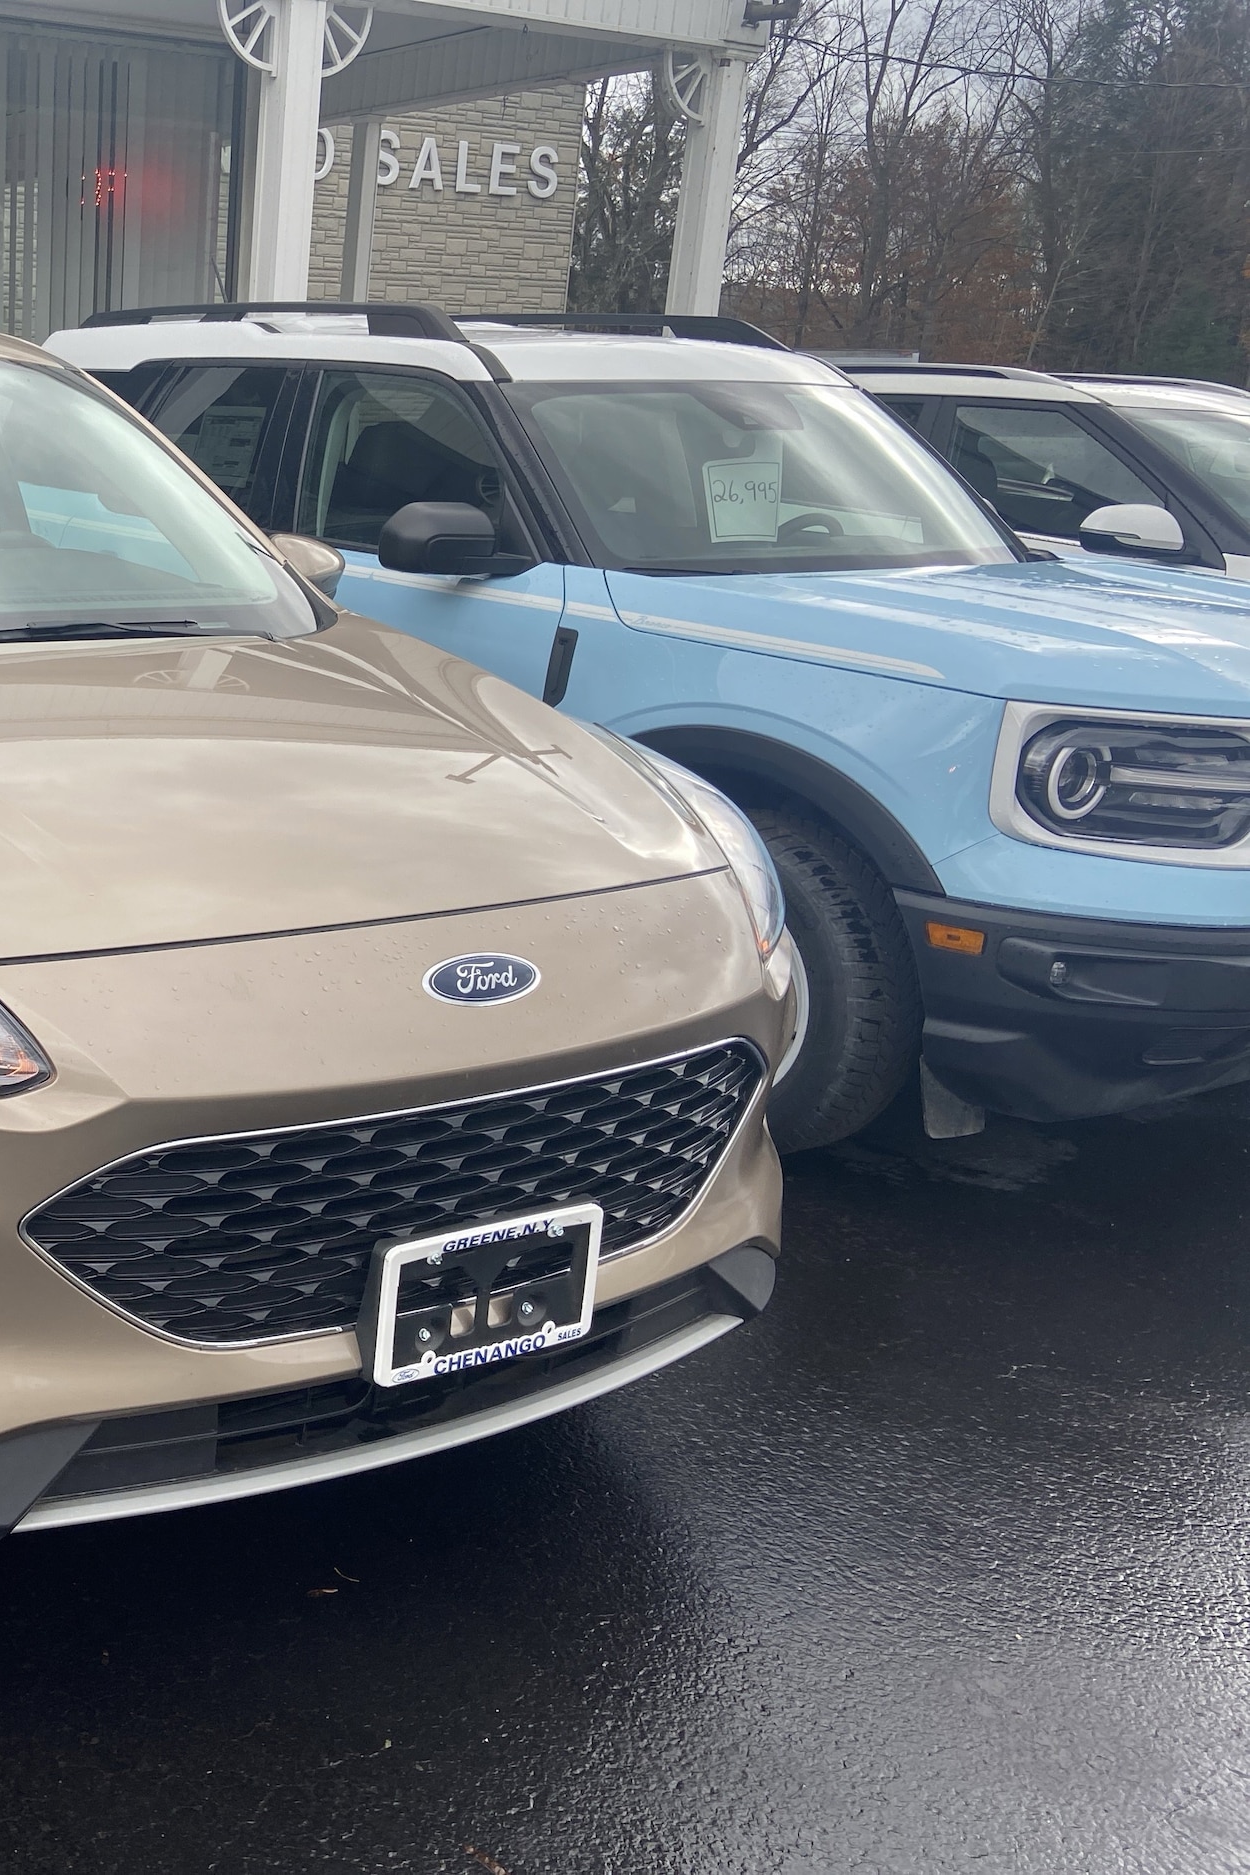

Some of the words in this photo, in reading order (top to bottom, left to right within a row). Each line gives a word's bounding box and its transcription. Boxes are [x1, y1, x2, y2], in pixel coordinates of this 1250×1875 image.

[377, 129, 559, 199] SALES
[712, 479, 778, 505] 26,995
[456, 961, 518, 994] Ford
[433, 1334, 546, 1375] CHENANGO
[557, 1327, 582, 1341] SALES
